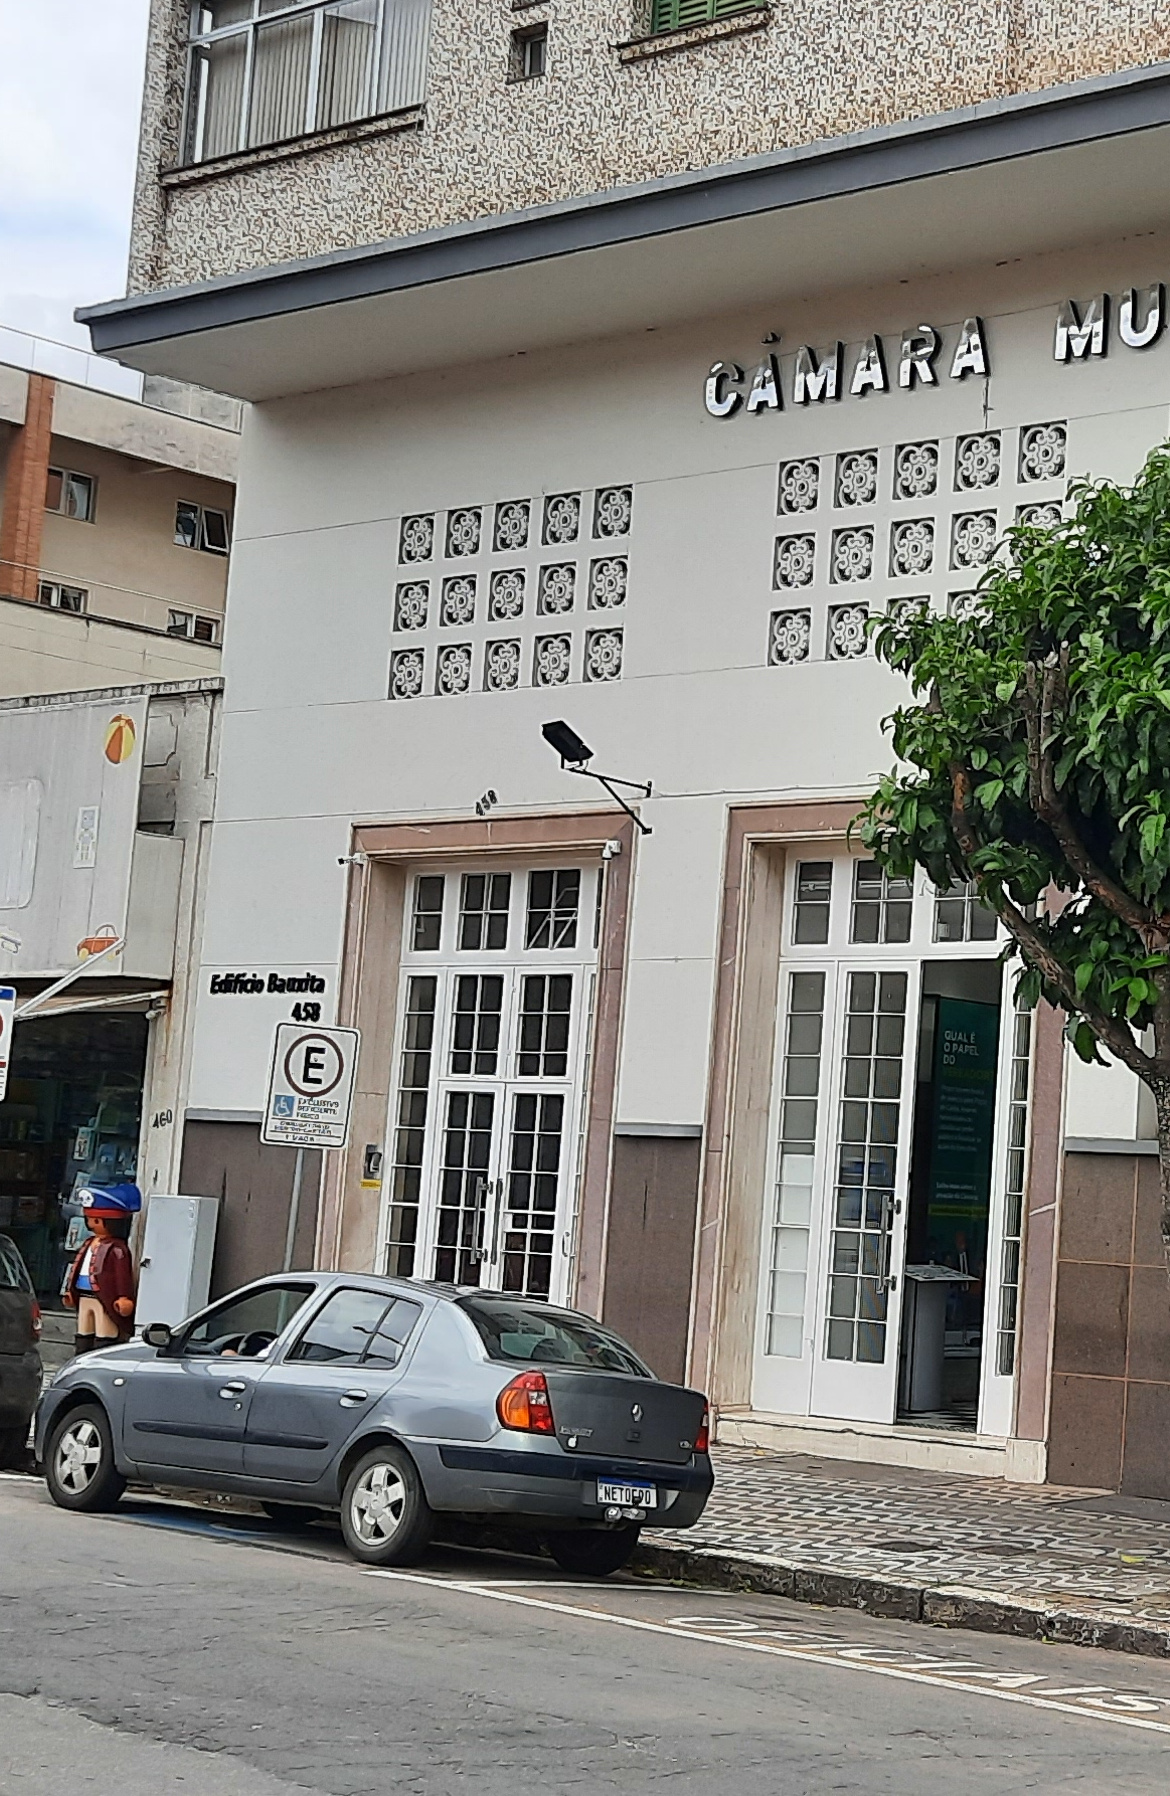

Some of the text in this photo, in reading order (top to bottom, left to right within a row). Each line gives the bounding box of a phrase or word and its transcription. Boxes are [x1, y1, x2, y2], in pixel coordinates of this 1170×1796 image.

[703, 314, 988, 418] CÂMARA
[291, 1001, 321, 1022] 458
[944, 1030, 976, 1044] QUAL É
[943, 1042, 979, 1056] O PAPEL
[302, 1046, 326, 1085] E
[943, 1053, 956, 1065] DO
